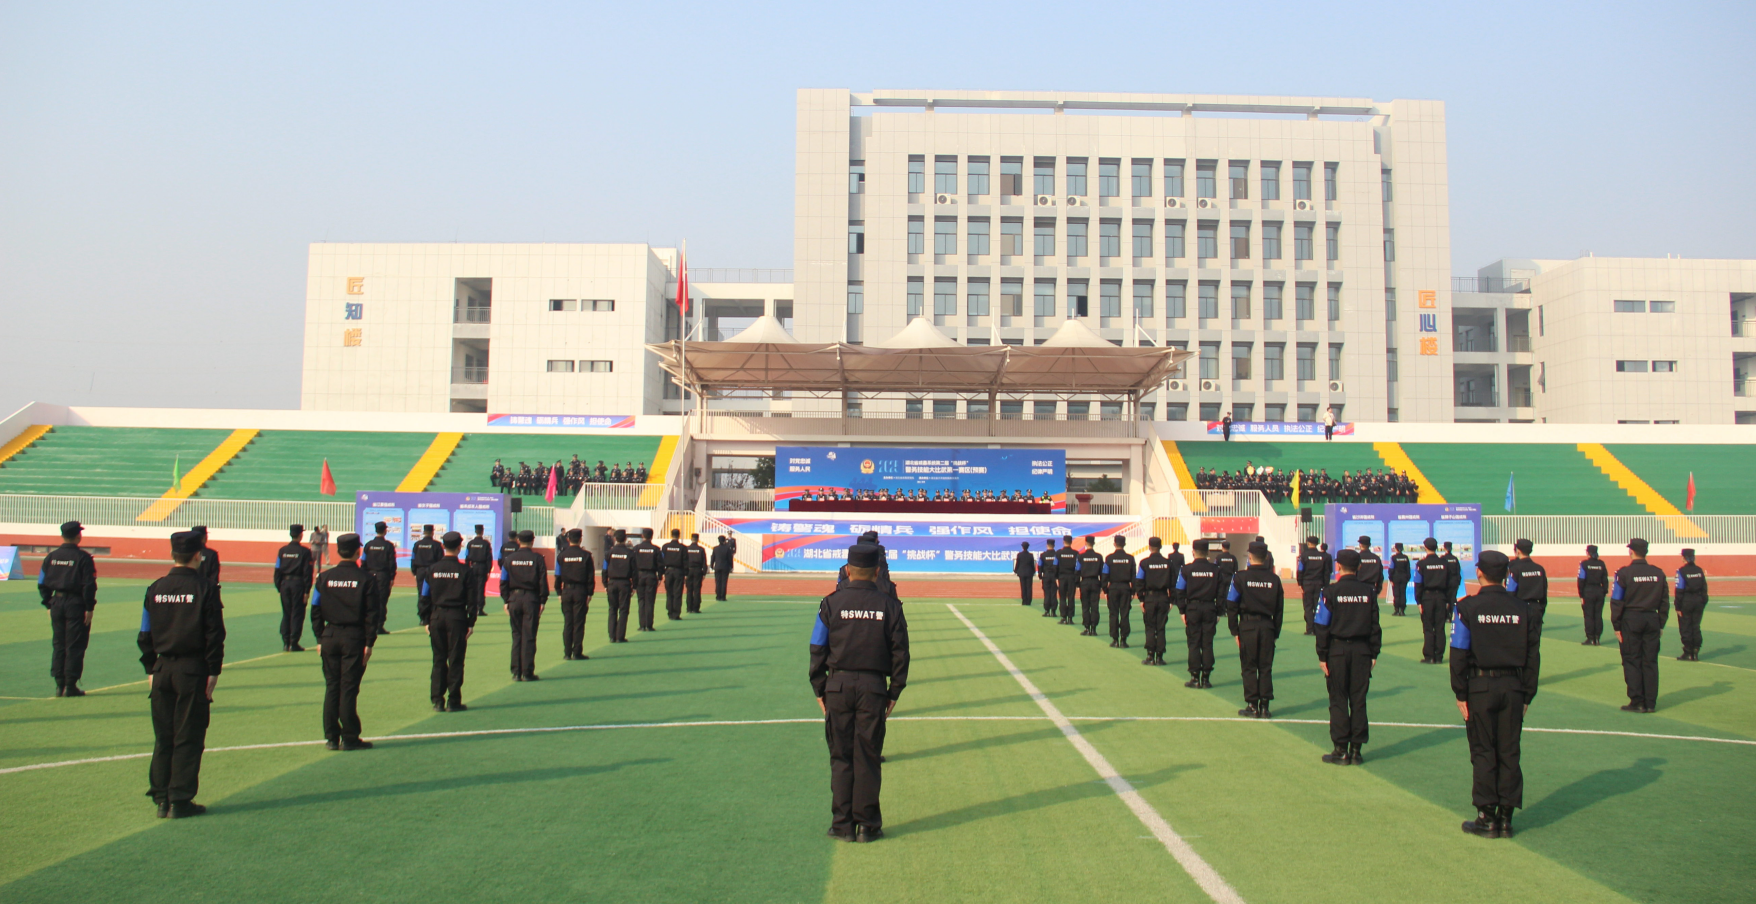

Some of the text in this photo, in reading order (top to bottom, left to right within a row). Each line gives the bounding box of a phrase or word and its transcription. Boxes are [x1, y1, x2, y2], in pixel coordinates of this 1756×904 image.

[1418, 290, 1438, 356] 匠心楼
[563, 416, 585, 425] 强作风
[589, 417, 612, 426] 担使命
[1216, 424, 1246, 433] 对忠诚
[1284, 424, 1313, 433] 执法公正
[771, 522, 835, 534] 铸警魂
[929, 525, 994, 536] 强作风
[1009, 526, 1072, 536] 担使命
[327, 580, 358, 588] 特SWAT警
[1246, 580, 1273, 589] 特SWAT警
[154, 594, 194, 604] 特SWAT警
[1336, 595, 1369, 603] 特SWAT警
[840, 609, 884, 621] 特SWAT警
[1477, 614, 1520, 624] 特SWAT警
